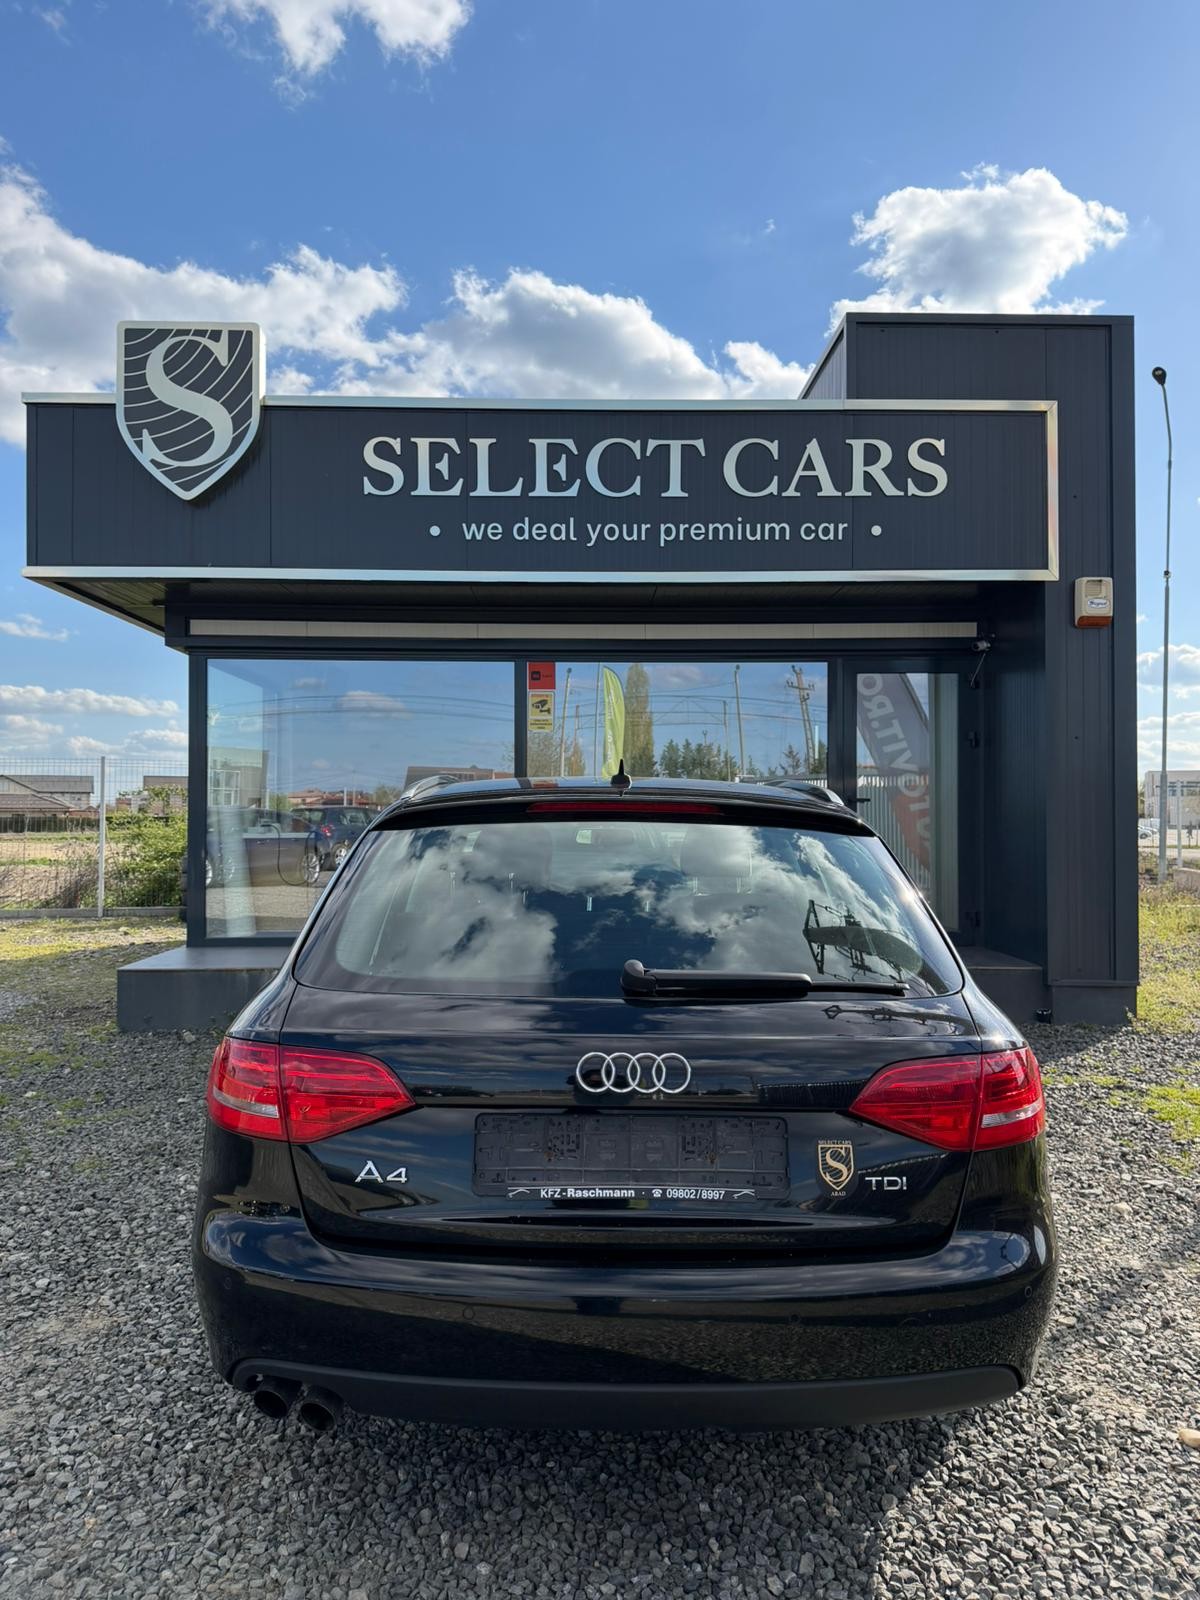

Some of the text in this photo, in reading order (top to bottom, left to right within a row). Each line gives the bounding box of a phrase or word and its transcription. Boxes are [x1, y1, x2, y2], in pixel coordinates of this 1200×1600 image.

[142, 330, 233, 467] S
[362, 436, 948, 498] SELECT CARS
[461, 516, 848, 547] we deal your premium car
[354, 1160, 408, 1183] A4
[865, 1176, 907, 1191] TDI
[540, 1187, 726, 1201] KFZ-Raschmann 09802/8997
